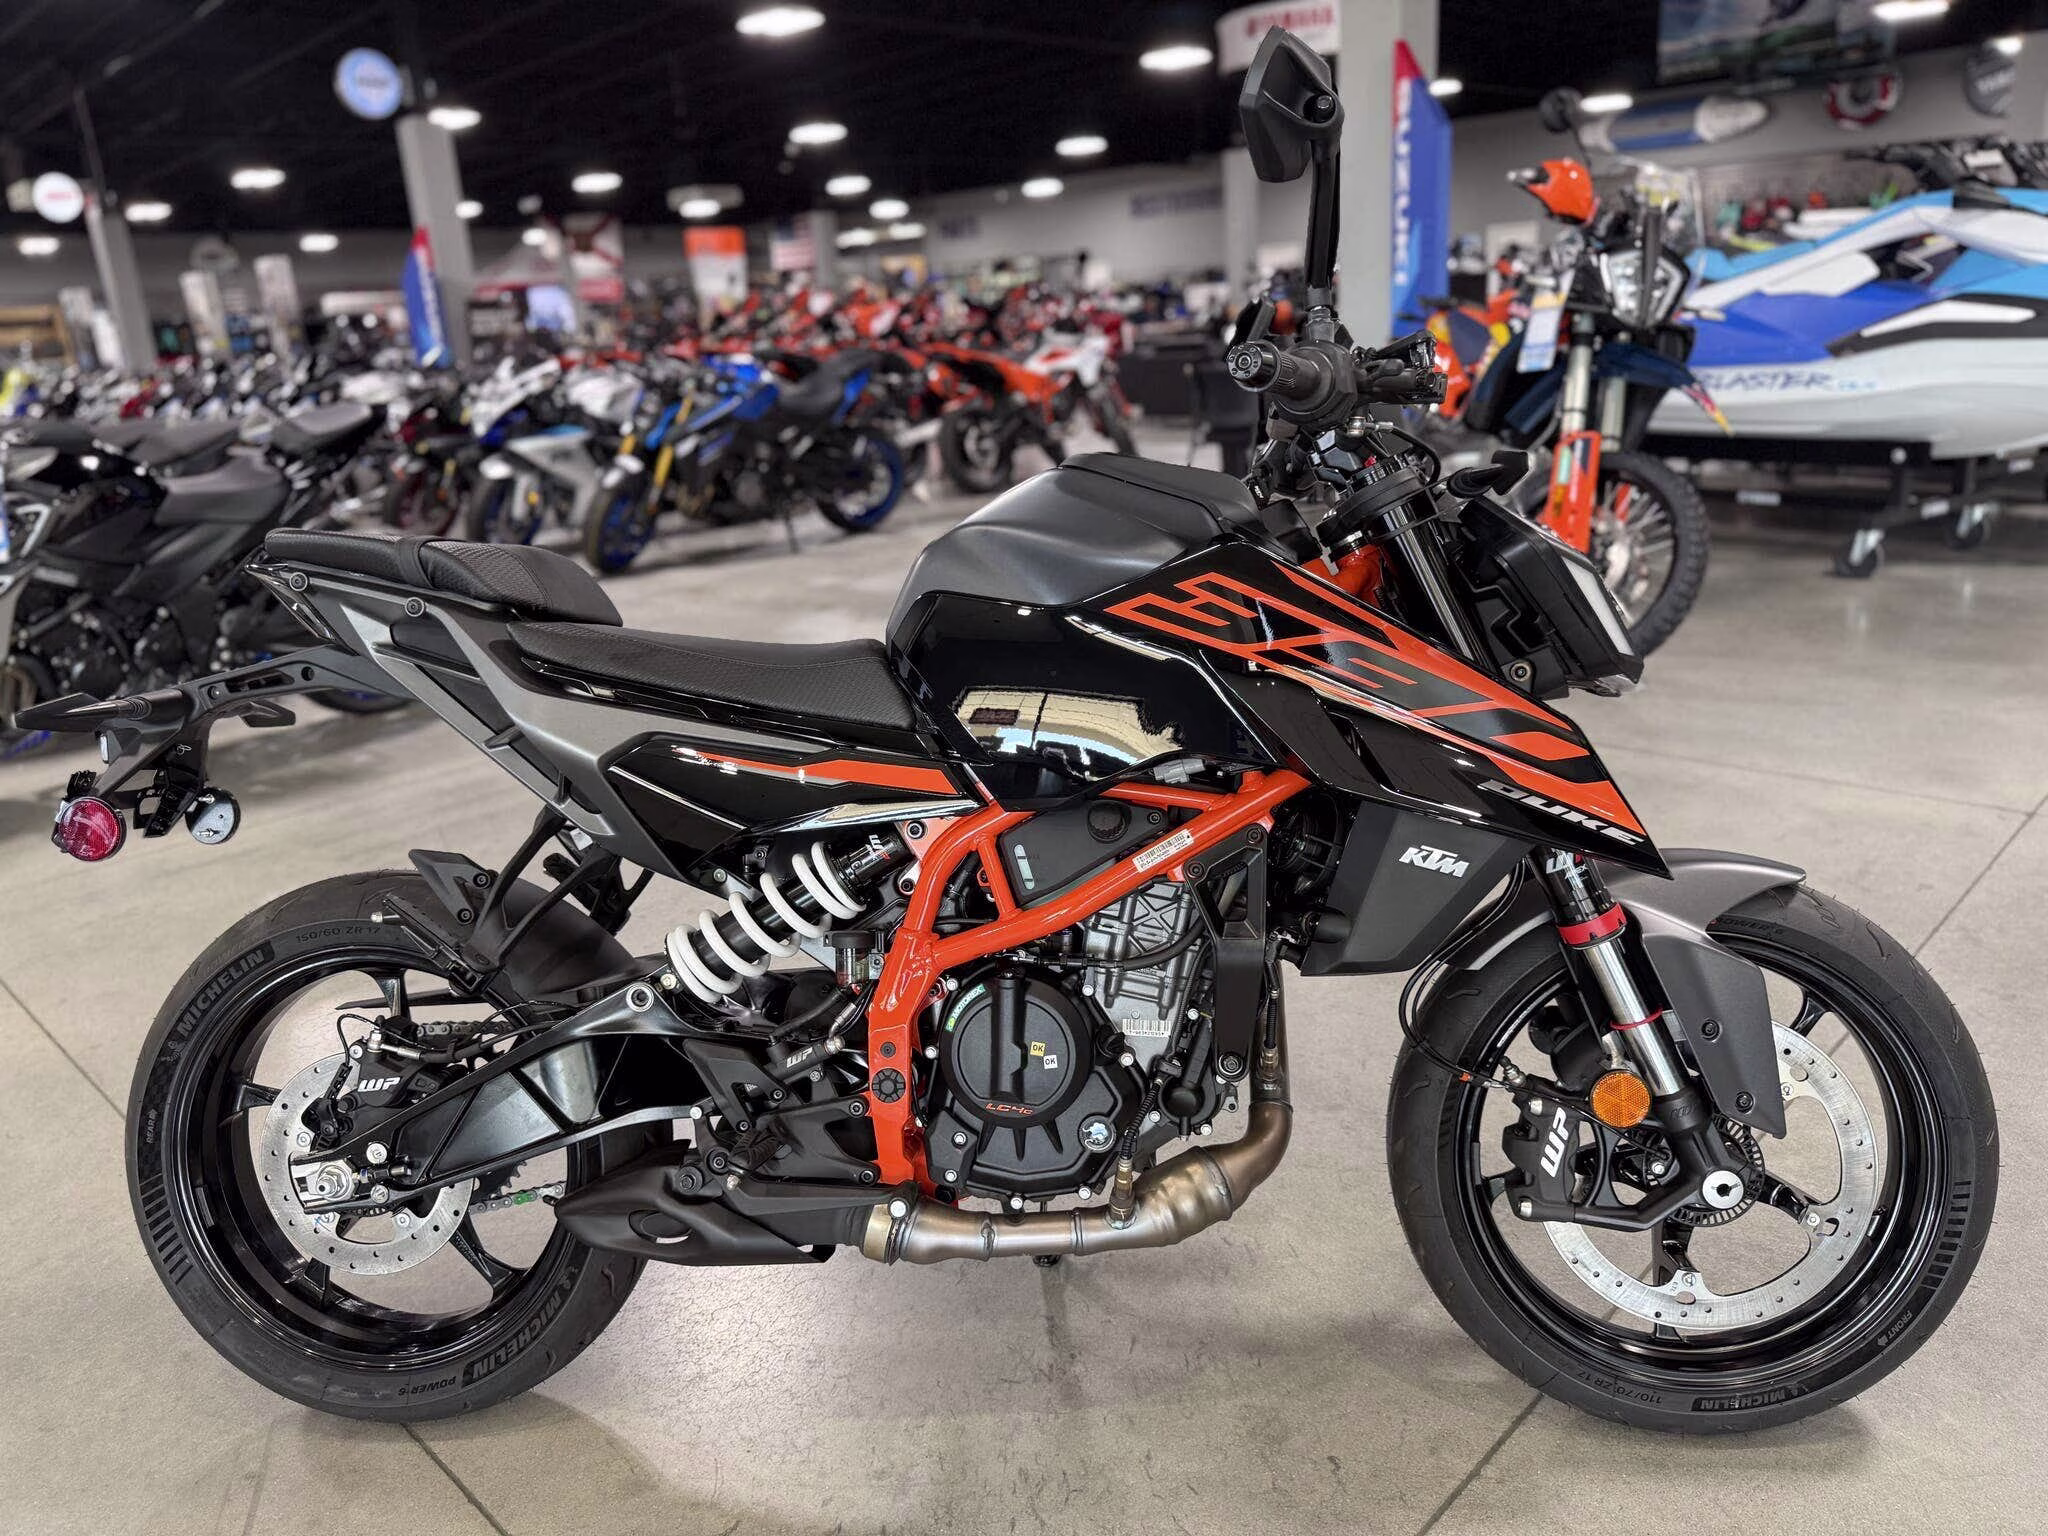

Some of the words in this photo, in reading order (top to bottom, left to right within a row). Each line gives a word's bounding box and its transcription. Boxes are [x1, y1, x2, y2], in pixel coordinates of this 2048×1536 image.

[1477, 779, 1647, 846] DUKE
[1398, 845, 1471, 878] KTM
[295, 927, 341, 943] 150/60
[345, 926, 362, 935] ZR
[367, 926, 381, 935] 17
[176, 948, 265, 1036] MICHELIN
[952, 984, 986, 1019] MOTOREX
[786, 1048, 814, 1069] WP
[1032, 1043, 1044, 1053] OK
[1044, 1057, 1056, 1066] OK
[357, 1076, 401, 1093] WP
[144, 1119, 157, 1145] REAR
[1540, 1107, 1582, 1178] WP
[473, 1291, 562, 1380] MICHELIN
[1887, 1309, 1913, 1340] FRONT
[410, 1375, 457, 1395] POWER
[1575, 1370, 1592, 1381] 17
[1594, 1377, 1614, 1390] ZR
[1616, 1386, 1663, 1405] 110/70
[1699, 1388, 1786, 1411] MICHELIN
